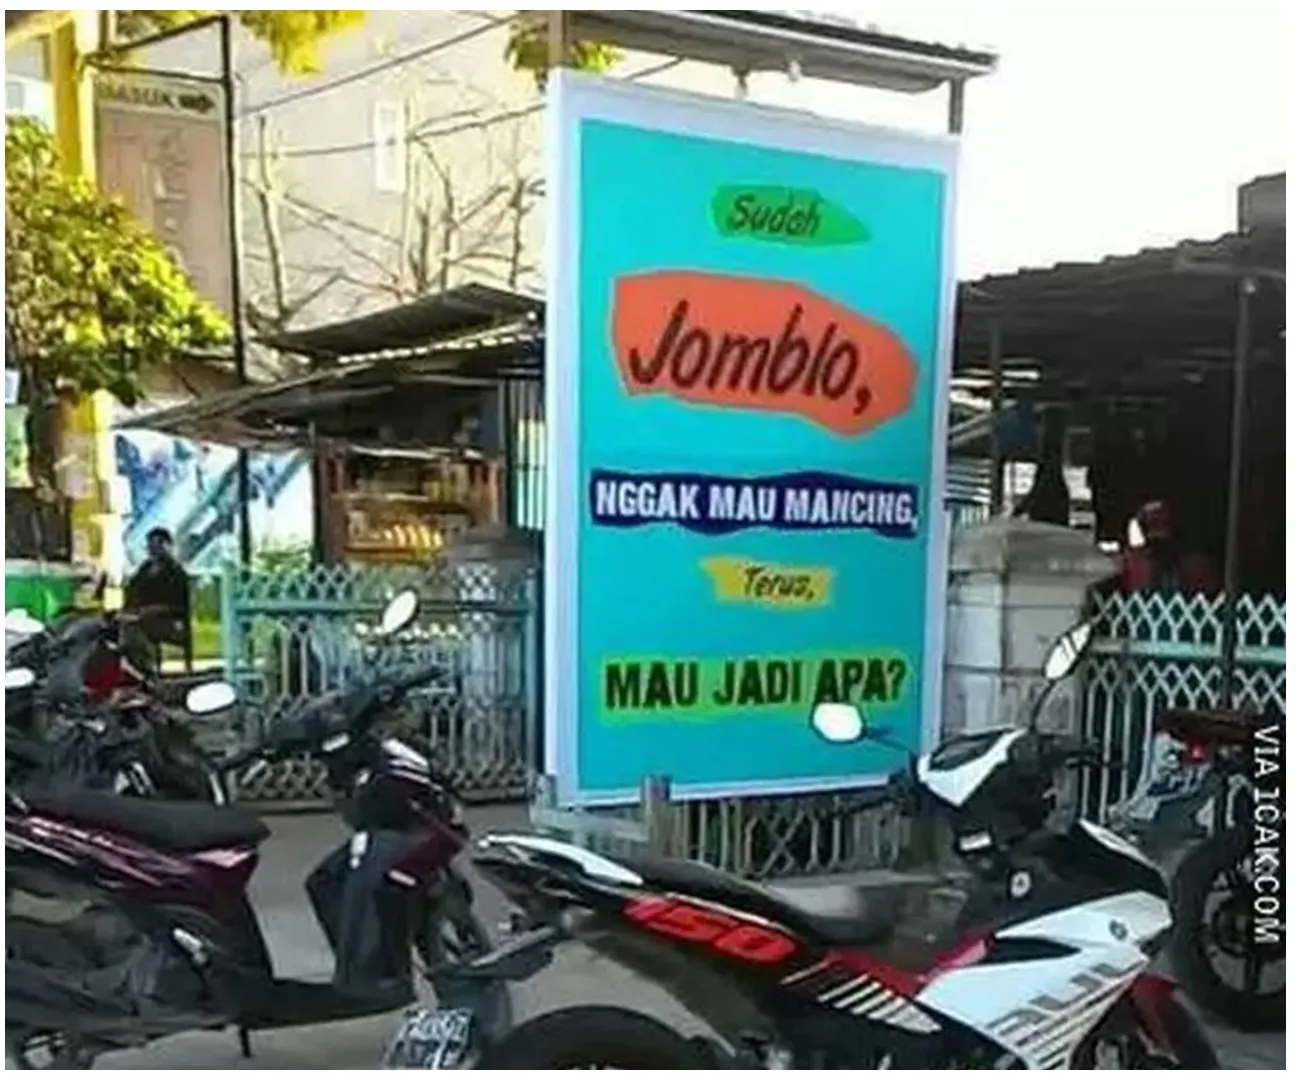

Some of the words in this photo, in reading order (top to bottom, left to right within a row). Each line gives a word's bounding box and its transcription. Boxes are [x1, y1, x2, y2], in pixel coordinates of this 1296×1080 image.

[725, 188, 823, 238] Sudah
[627, 299, 874, 416] Jomblo,
[595, 479, 701, 520] NGGAK
[707, 484, 776, 522] MAU
[784, 488, 918, 533] MANCING,
[744, 564, 815, 602] Terus,
[605, 661, 700, 710] MAU
[712, 658, 802, 706] JADI
[813, 657, 907, 704] APA?
[625, 893, 798, 963] 150
